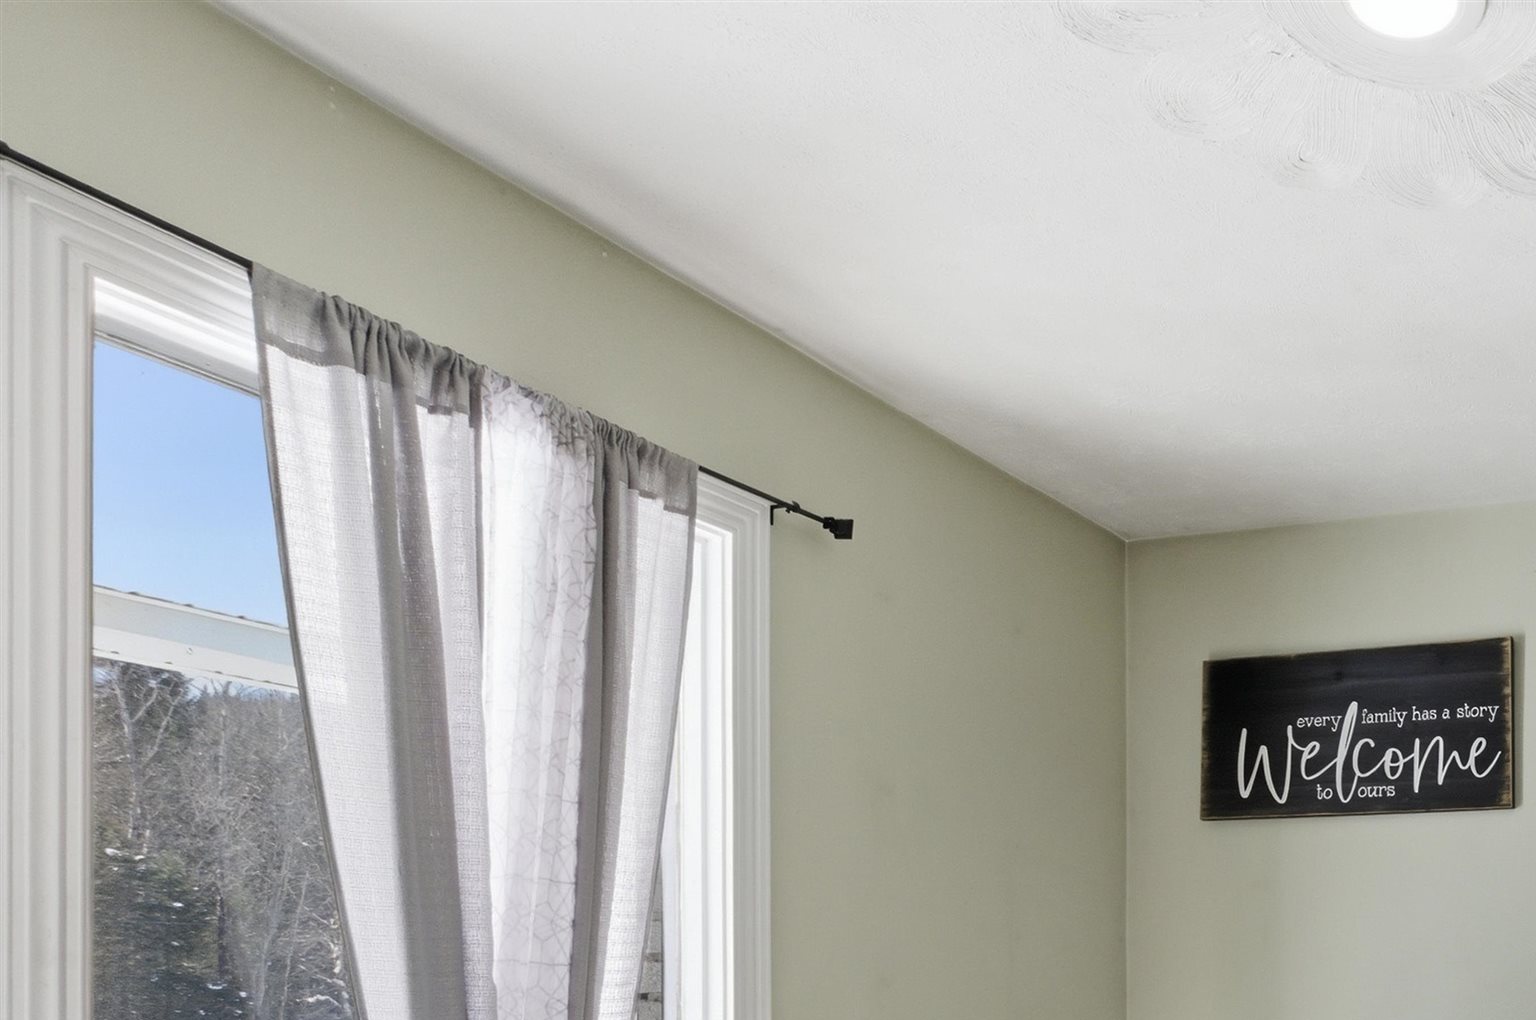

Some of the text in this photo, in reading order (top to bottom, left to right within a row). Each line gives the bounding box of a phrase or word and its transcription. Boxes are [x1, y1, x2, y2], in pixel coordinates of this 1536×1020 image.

[1296, 703, 1500, 732] every family has a story
[1237, 701, 1502, 804] Welcome
[1316, 784, 1396, 800] to ours
